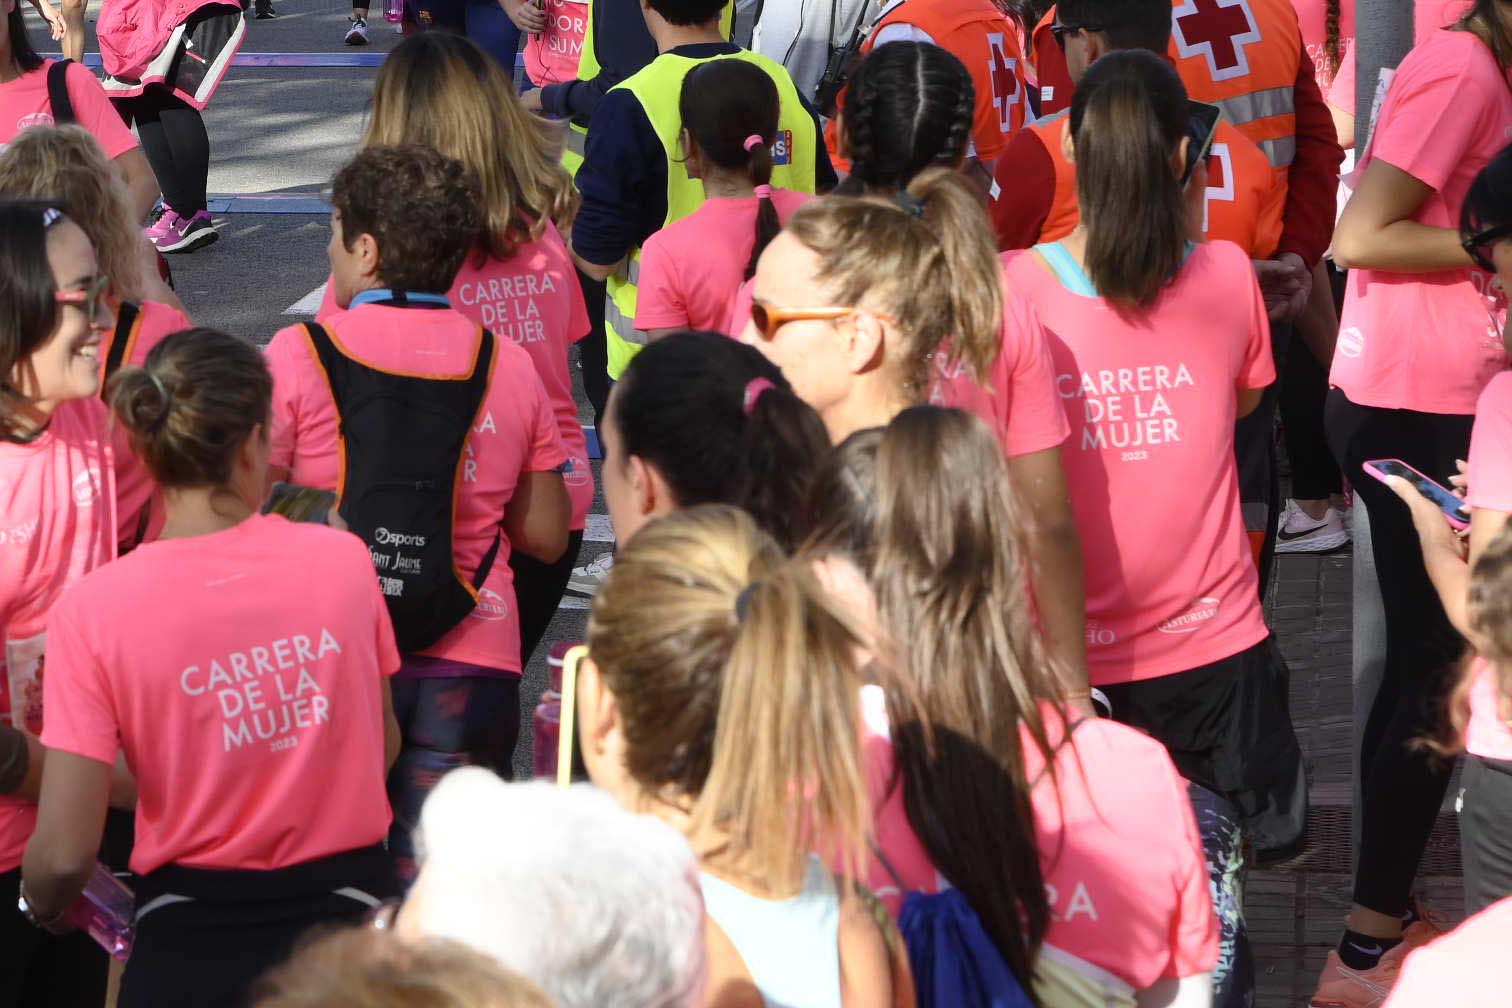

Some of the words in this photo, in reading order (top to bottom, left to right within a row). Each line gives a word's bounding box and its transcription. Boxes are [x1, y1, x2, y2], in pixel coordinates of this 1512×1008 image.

[548, 35, 584, 55] SUM
[459, 272, 557, 305] CARRERA
[481, 301, 509, 325] DE
[514, 297, 541, 320] LA
[1056, 363, 1195, 399] CARRERA
[1085, 399, 1123, 424] DE
[1135, 393, 1172, 418] LA
[1081, 418, 1181, 451] MUJER
[1120, 450, 1149, 462] 2023
[180, 627, 341, 697] CARRERA
[218, 684, 265, 719] DE
[278, 668, 321, 705] LA
[223, 696, 331, 753] MUJER
[268, 737, 299, 754] 2023
